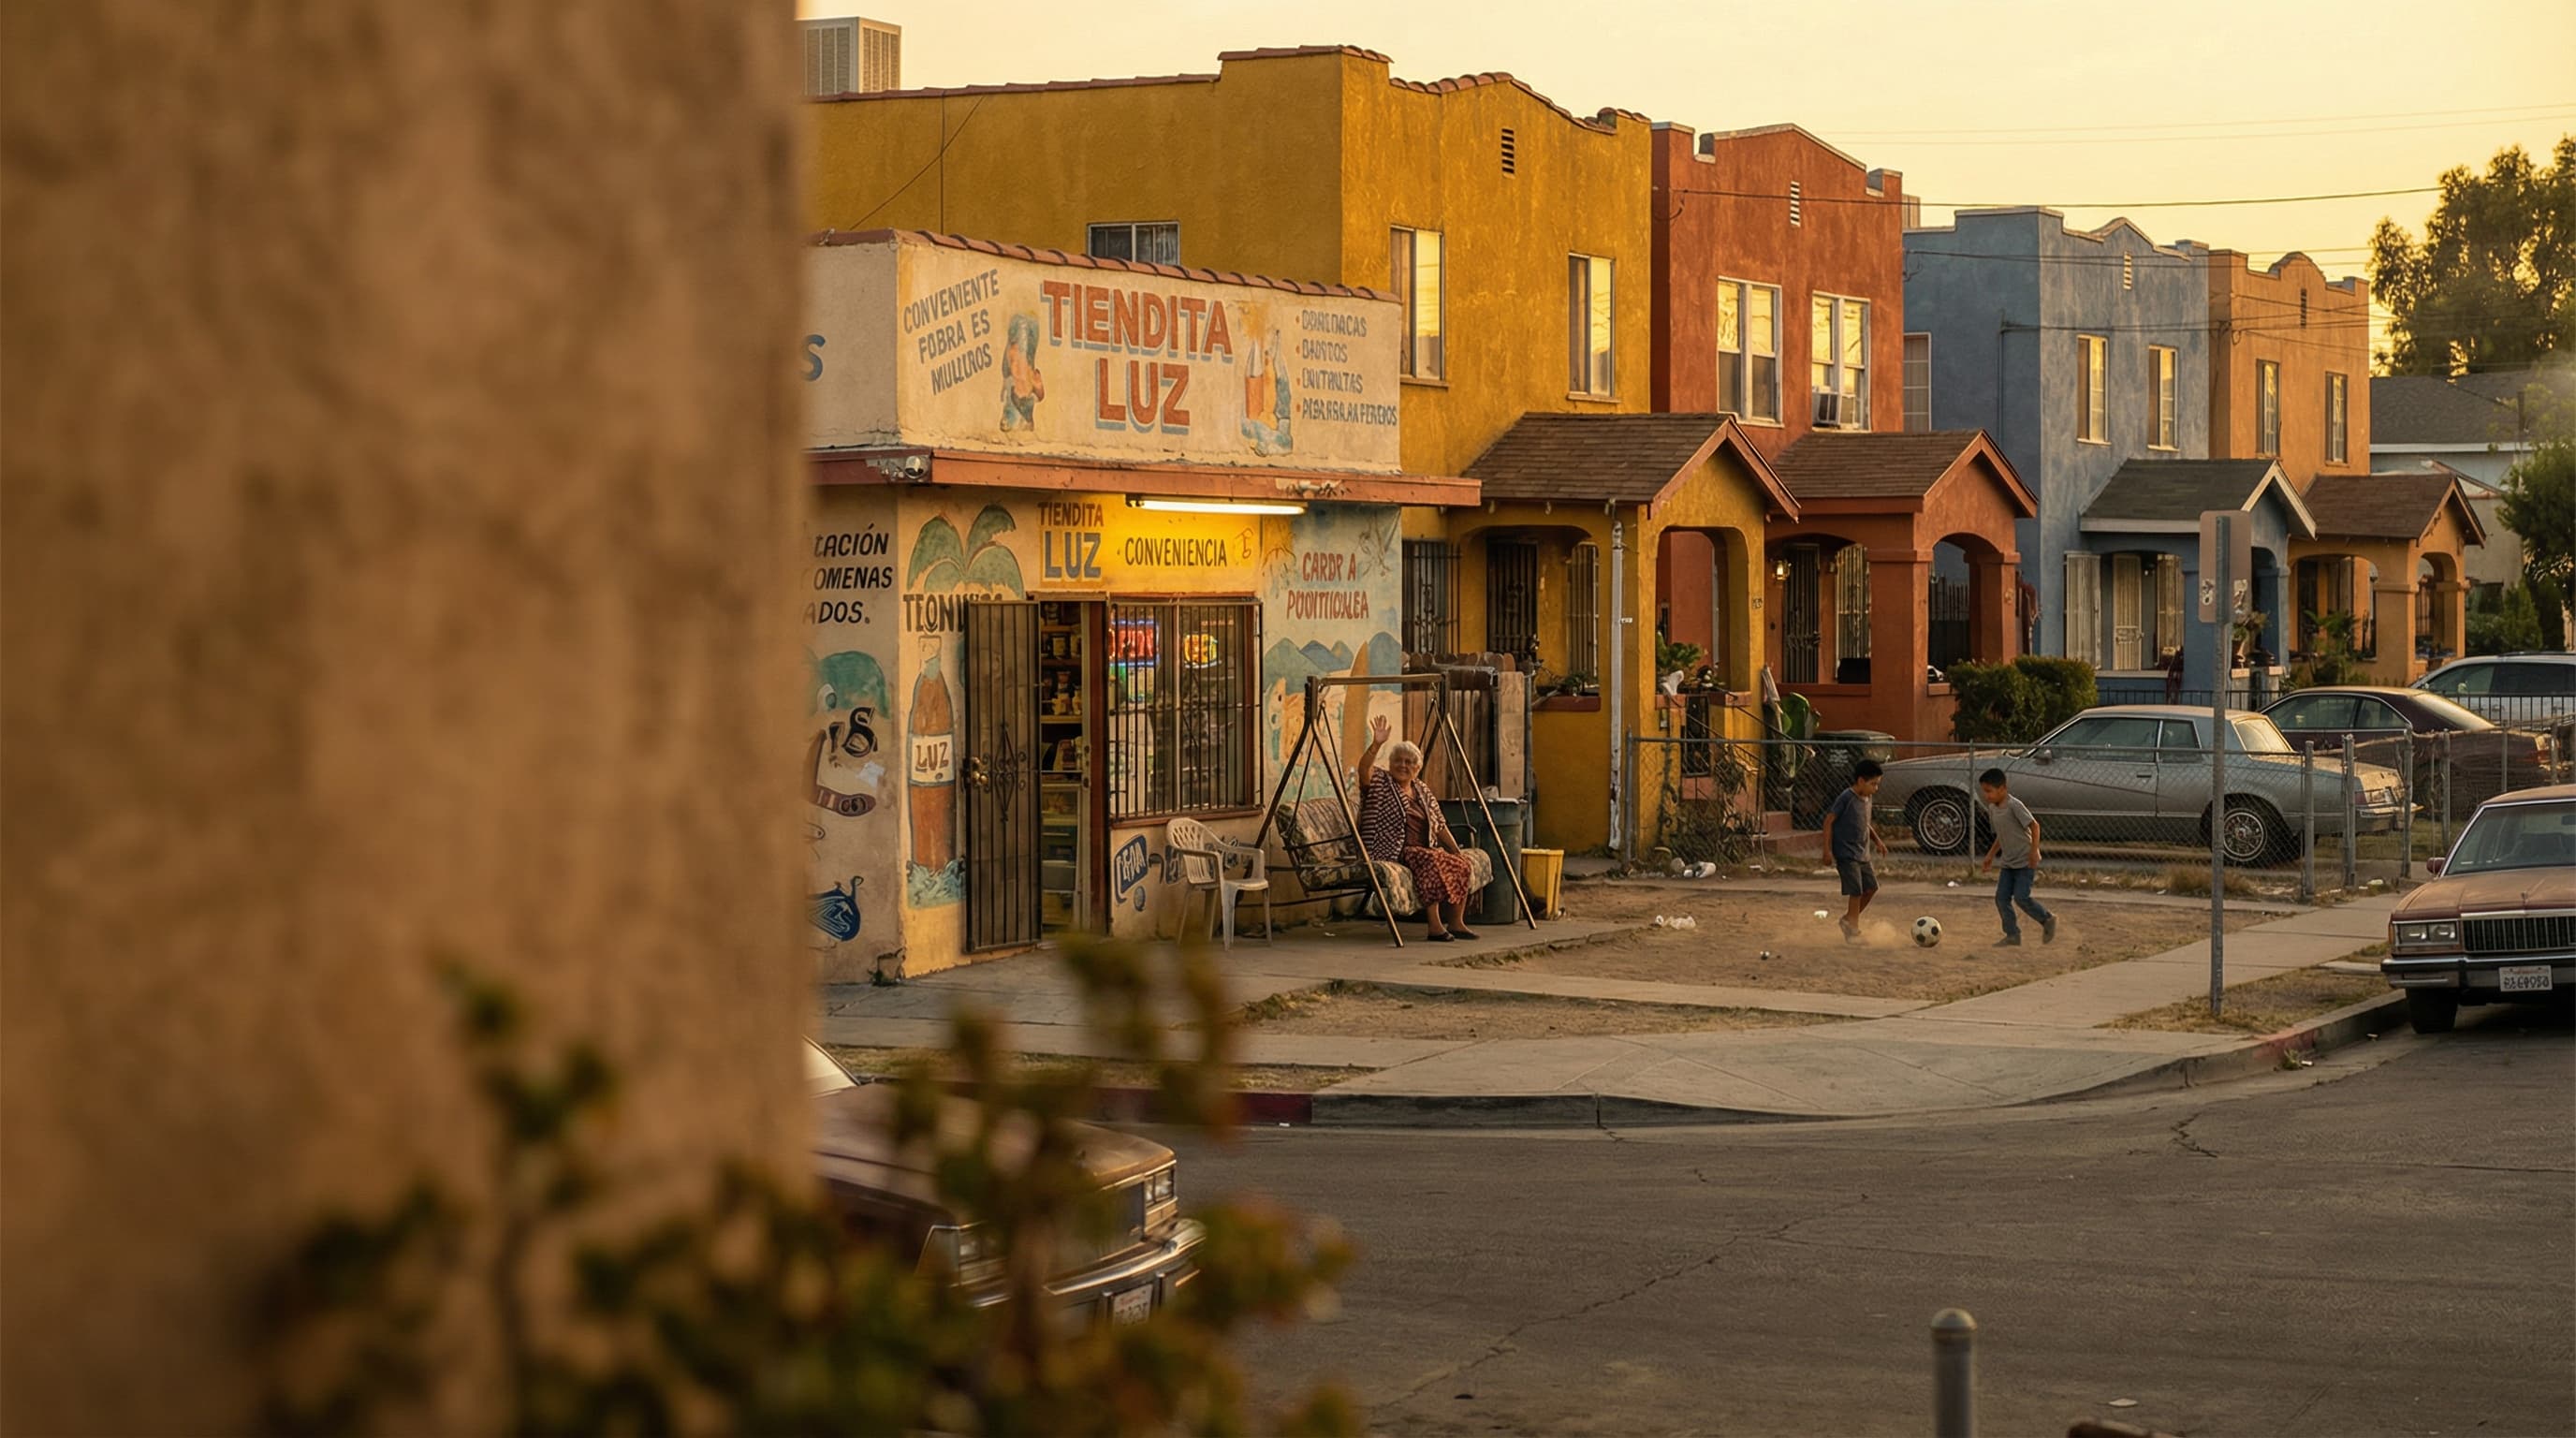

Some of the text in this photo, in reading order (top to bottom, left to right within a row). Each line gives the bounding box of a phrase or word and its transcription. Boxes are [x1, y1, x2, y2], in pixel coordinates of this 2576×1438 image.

[904, 269, 999, 334] CONVENIENTE
[1041, 280, 1233, 363] TIENDITA
[918, 308, 990, 364] FOBRA ES
[1095, 358, 1191, 435] LUZ
[1037, 501, 1104, 527] TIENDITA
[1045, 531, 1102, 579] LUZ
[1125, 536, 1227, 566] CONVENIENCIA
